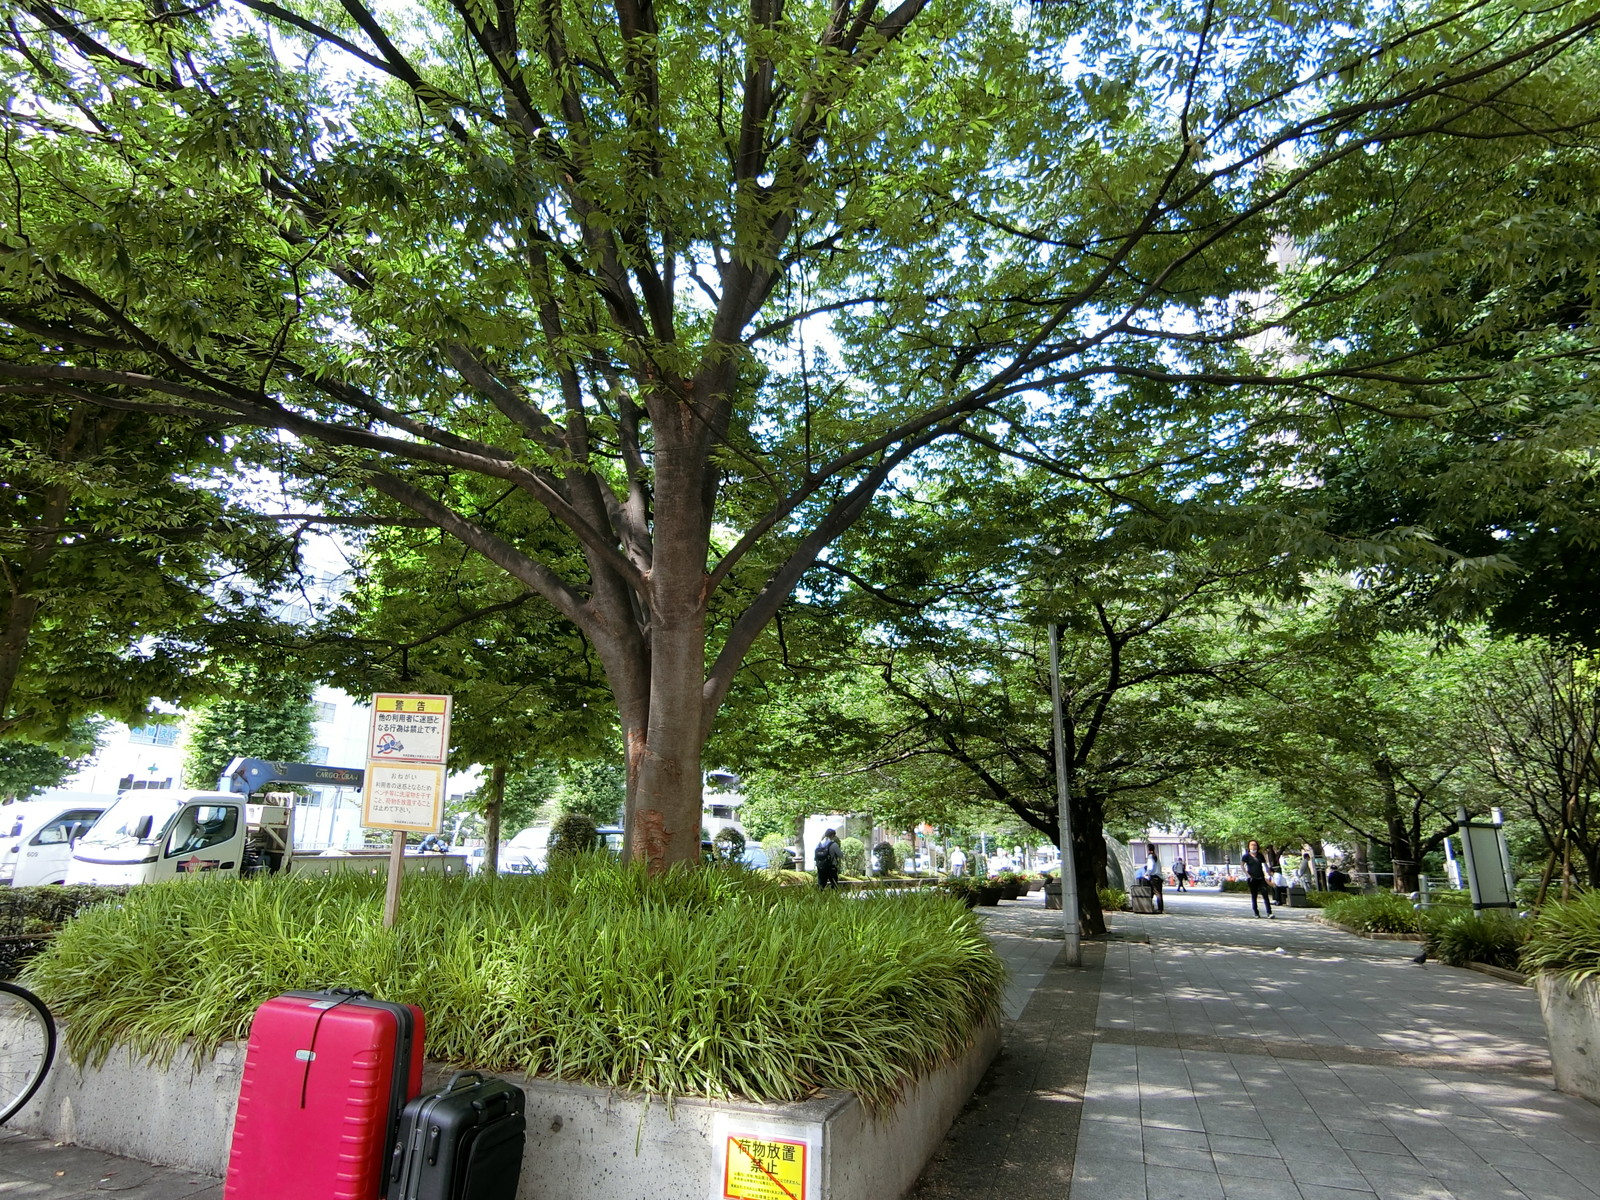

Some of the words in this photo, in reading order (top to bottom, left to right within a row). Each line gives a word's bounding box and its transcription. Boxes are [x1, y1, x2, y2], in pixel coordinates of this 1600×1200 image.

[395, 700, 426, 712] 警告
[379, 714, 440, 724] 他の利用者に迷惑と
[378, 724, 440, 735] なる行為は禁止です。
[391, 773, 417, 781] おねがい
[737, 1139, 796, 1163] 荷物放置
[750, 1157, 779, 1175] 禁止
